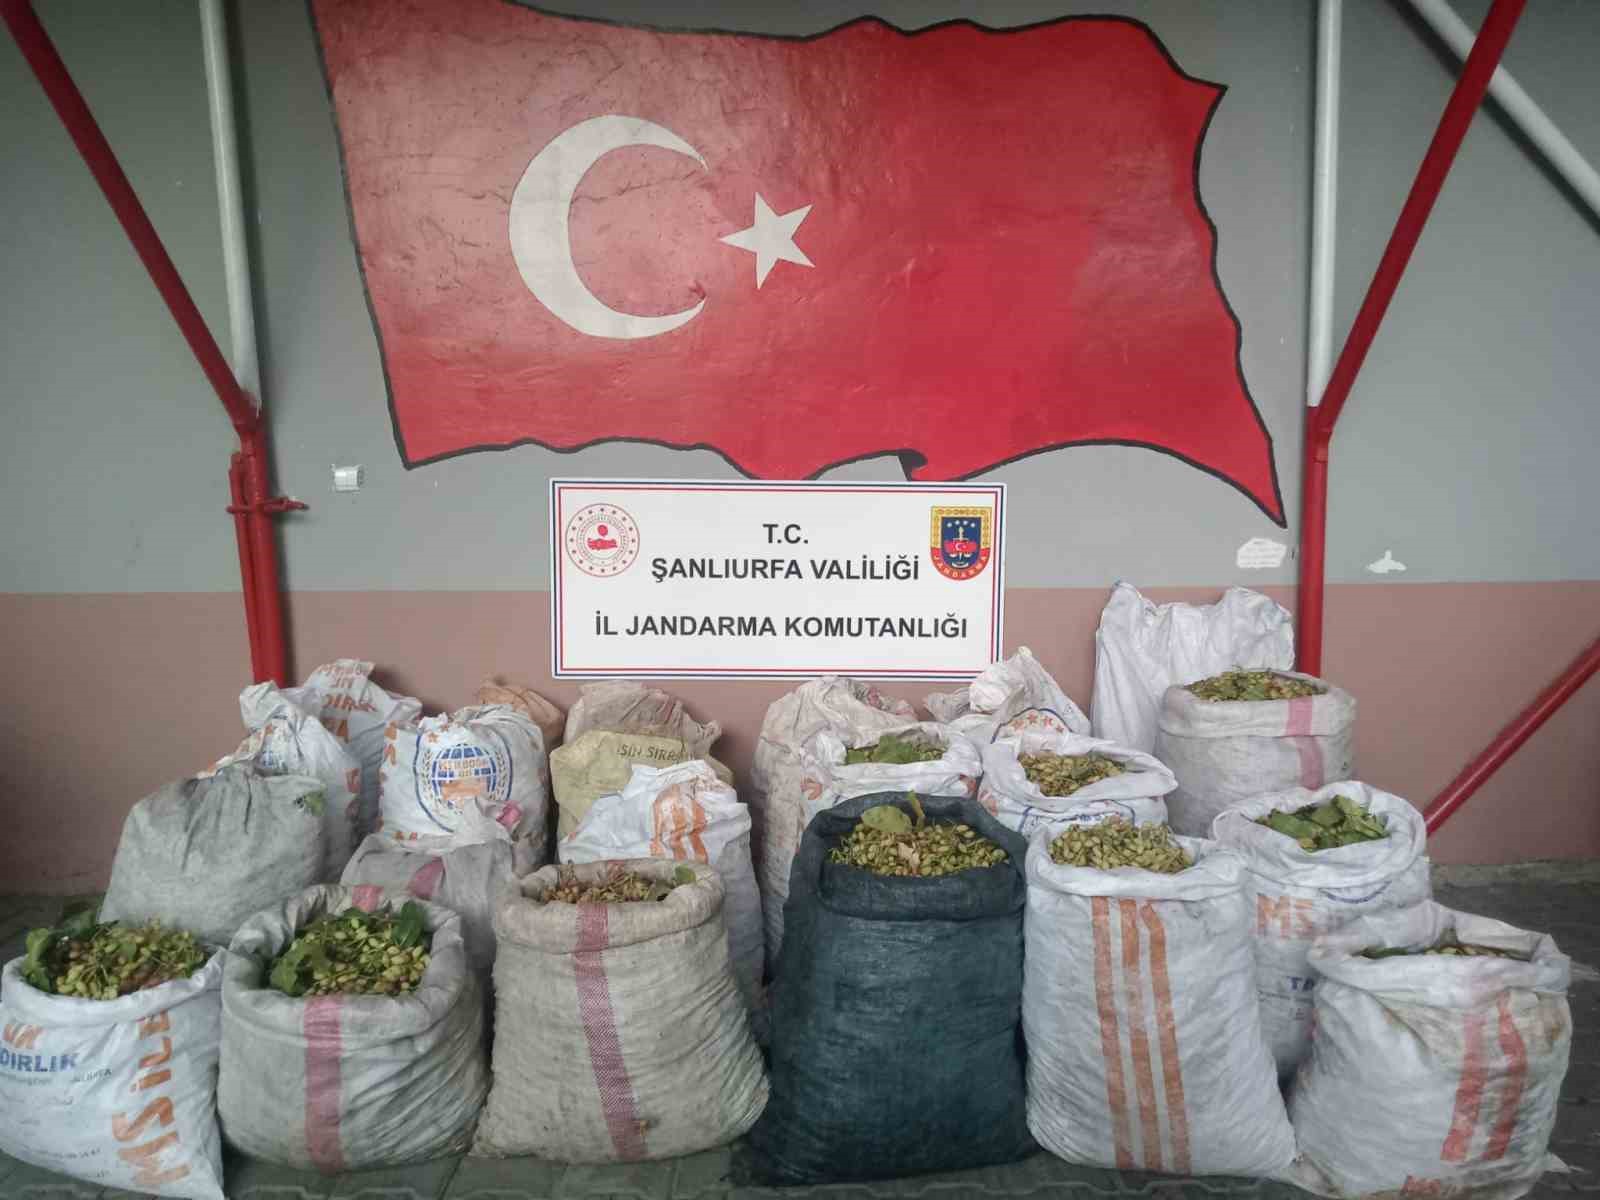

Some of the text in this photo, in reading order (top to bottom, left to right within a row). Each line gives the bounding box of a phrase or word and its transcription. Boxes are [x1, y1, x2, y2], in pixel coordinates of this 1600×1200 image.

[762, 523, 809, 545] T.C.
[651, 554, 920, 583] ŞANLIURFA VALİLİĞİ
[595, 610, 967, 639] İL JANDARMA KOMUTANLIĞI
